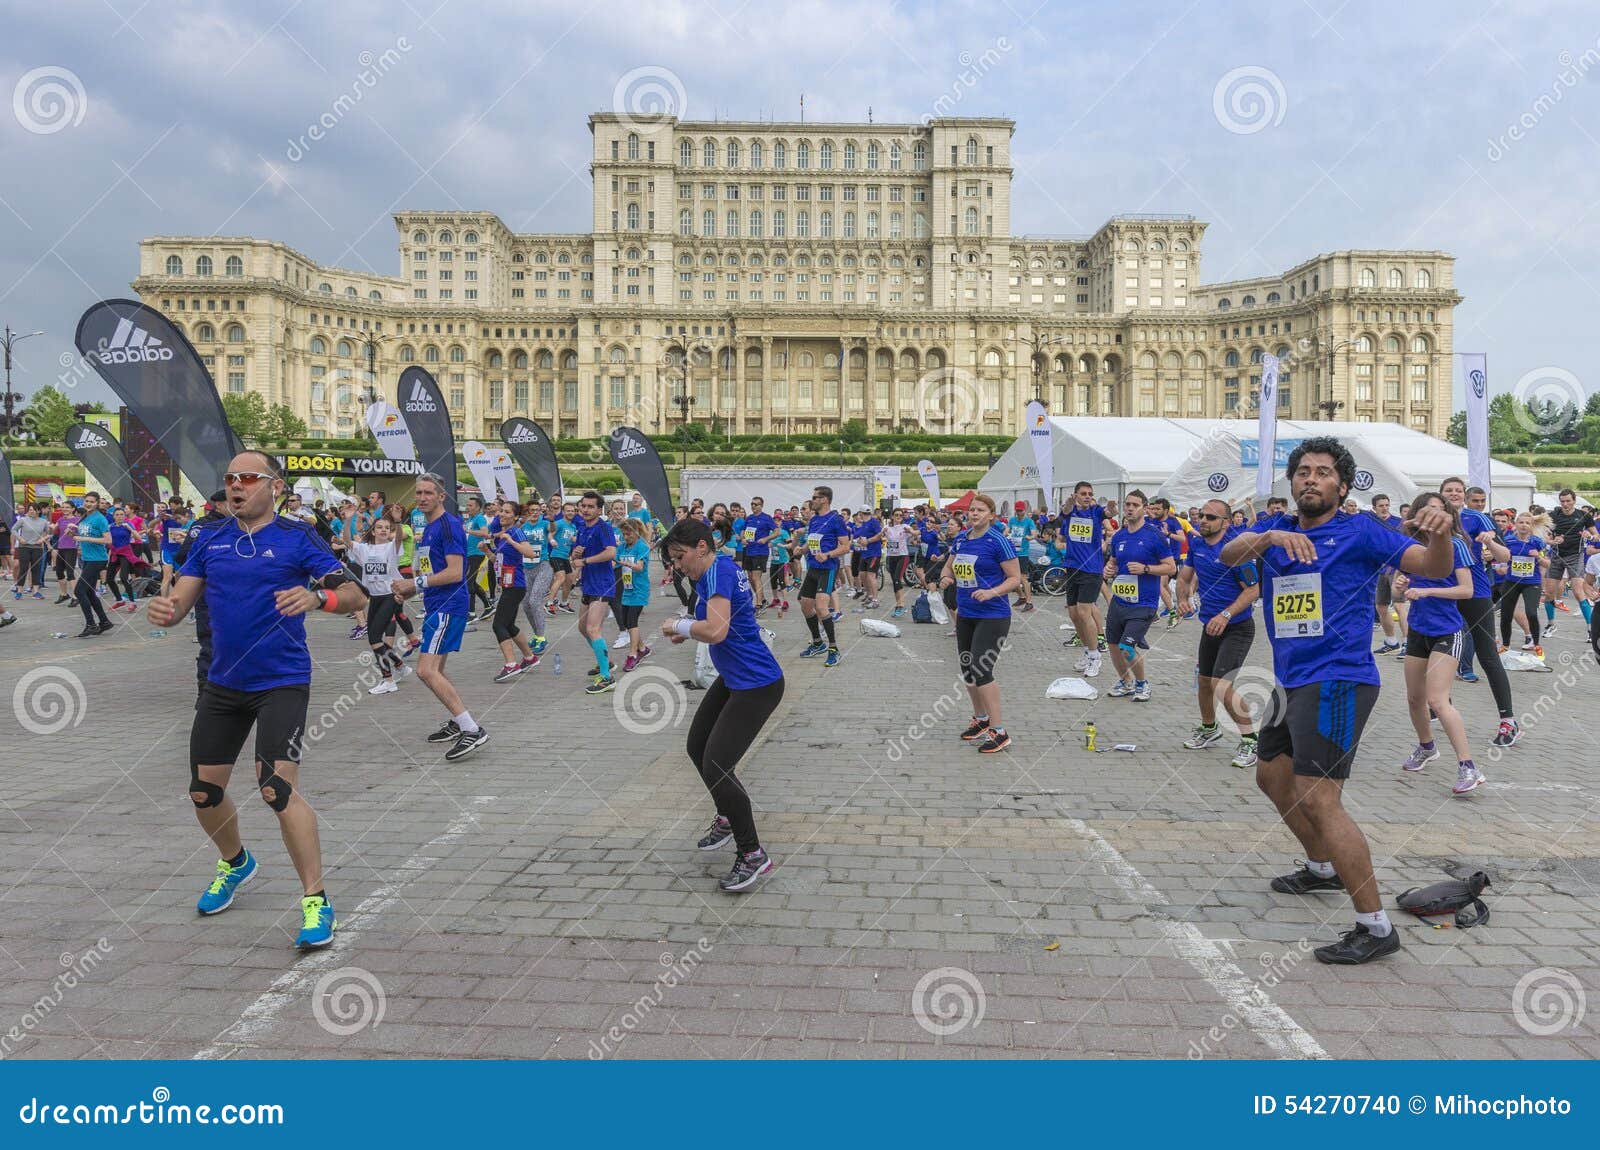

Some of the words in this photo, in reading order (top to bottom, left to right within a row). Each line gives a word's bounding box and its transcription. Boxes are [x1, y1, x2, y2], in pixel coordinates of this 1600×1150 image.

[376, 429, 407, 438] PETROM
[288, 456, 344, 471] BOOST
[351, 459, 394, 473] YOUR
[395, 460, 425, 475] RUN
[1071, 524, 1090, 535] 5135
[366, 563, 385, 573] CP296
[1114, 584, 1136, 595] 1869
[1277, 594, 1316, 614] 5275
